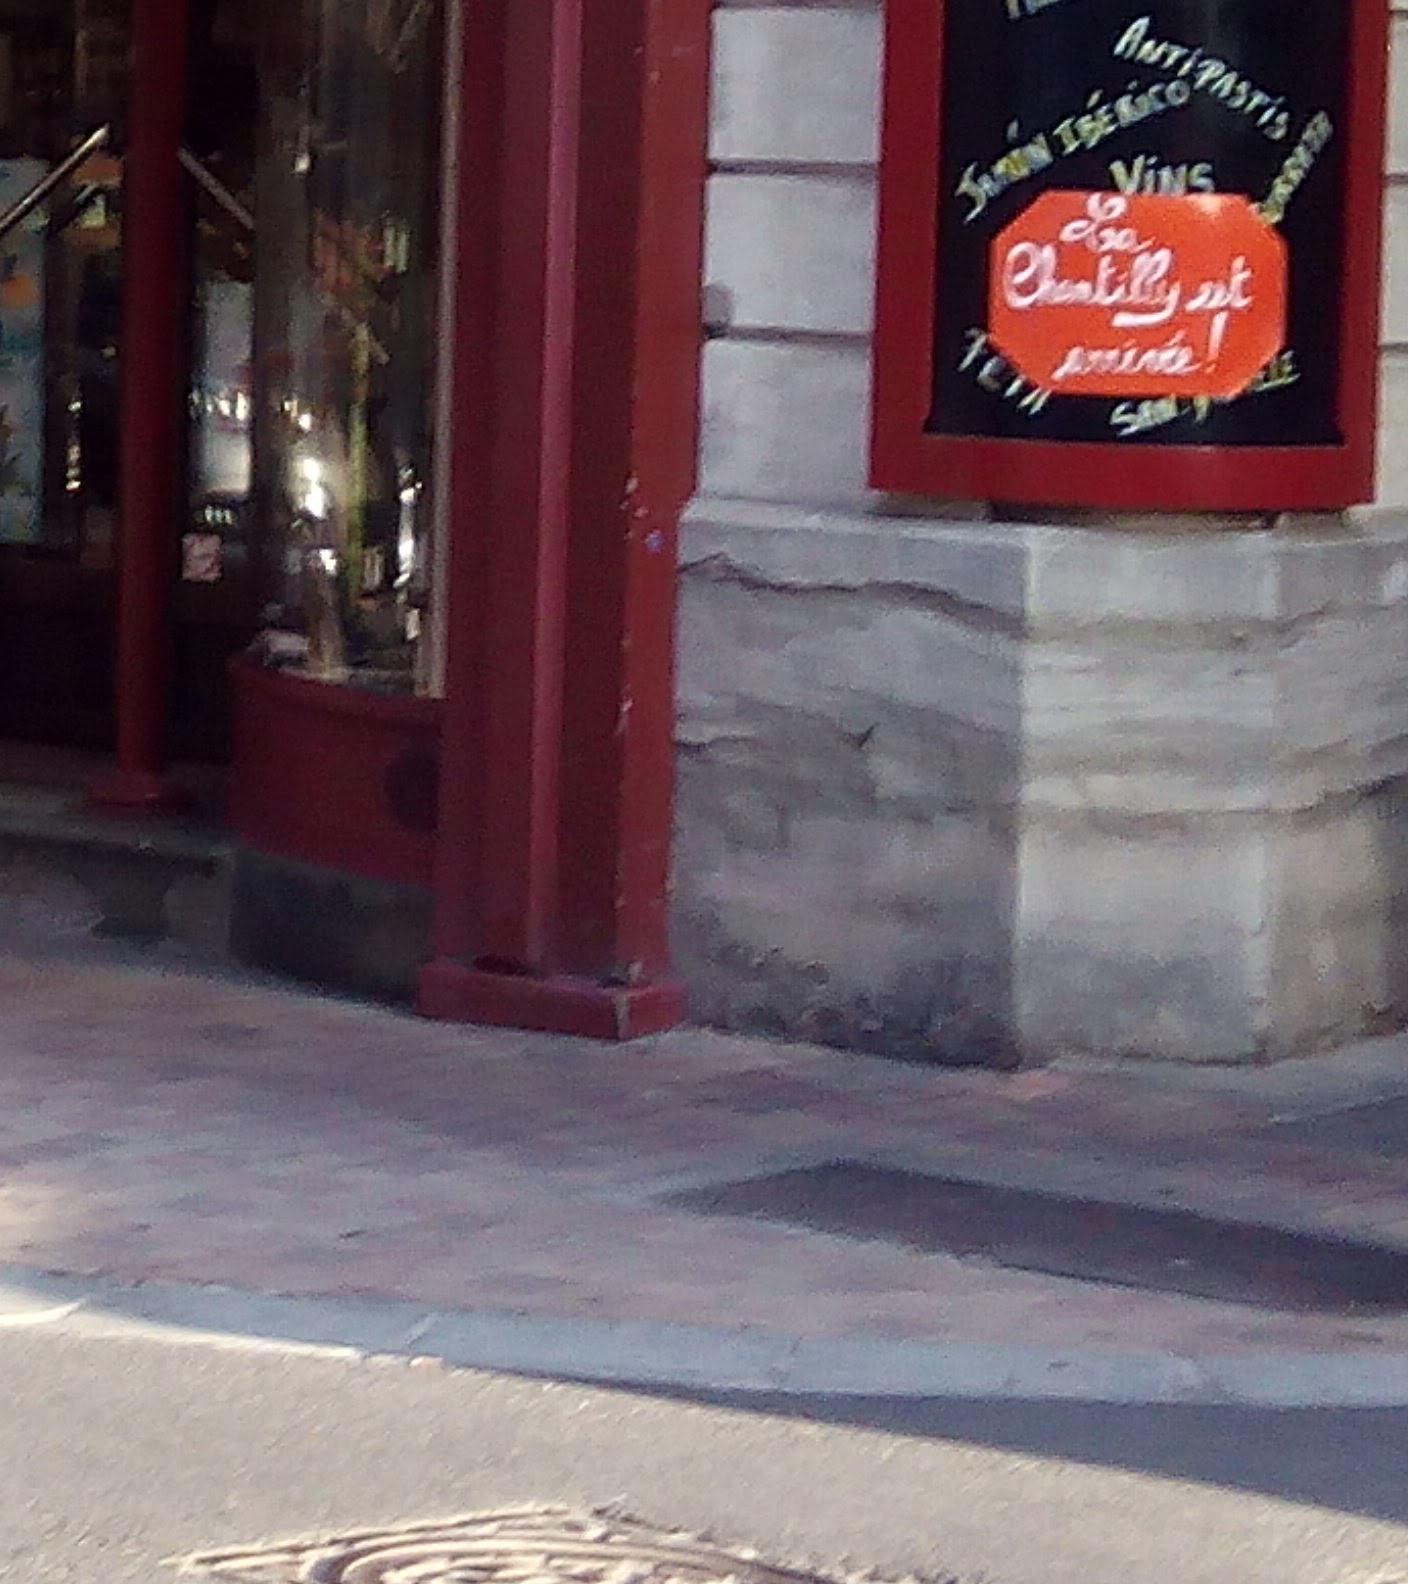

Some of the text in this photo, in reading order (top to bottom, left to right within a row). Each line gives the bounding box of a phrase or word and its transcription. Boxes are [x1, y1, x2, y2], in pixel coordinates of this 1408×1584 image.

[1058, 193, 1157, 252] La
[1002, 240, 1253, 328] Chantilly est
